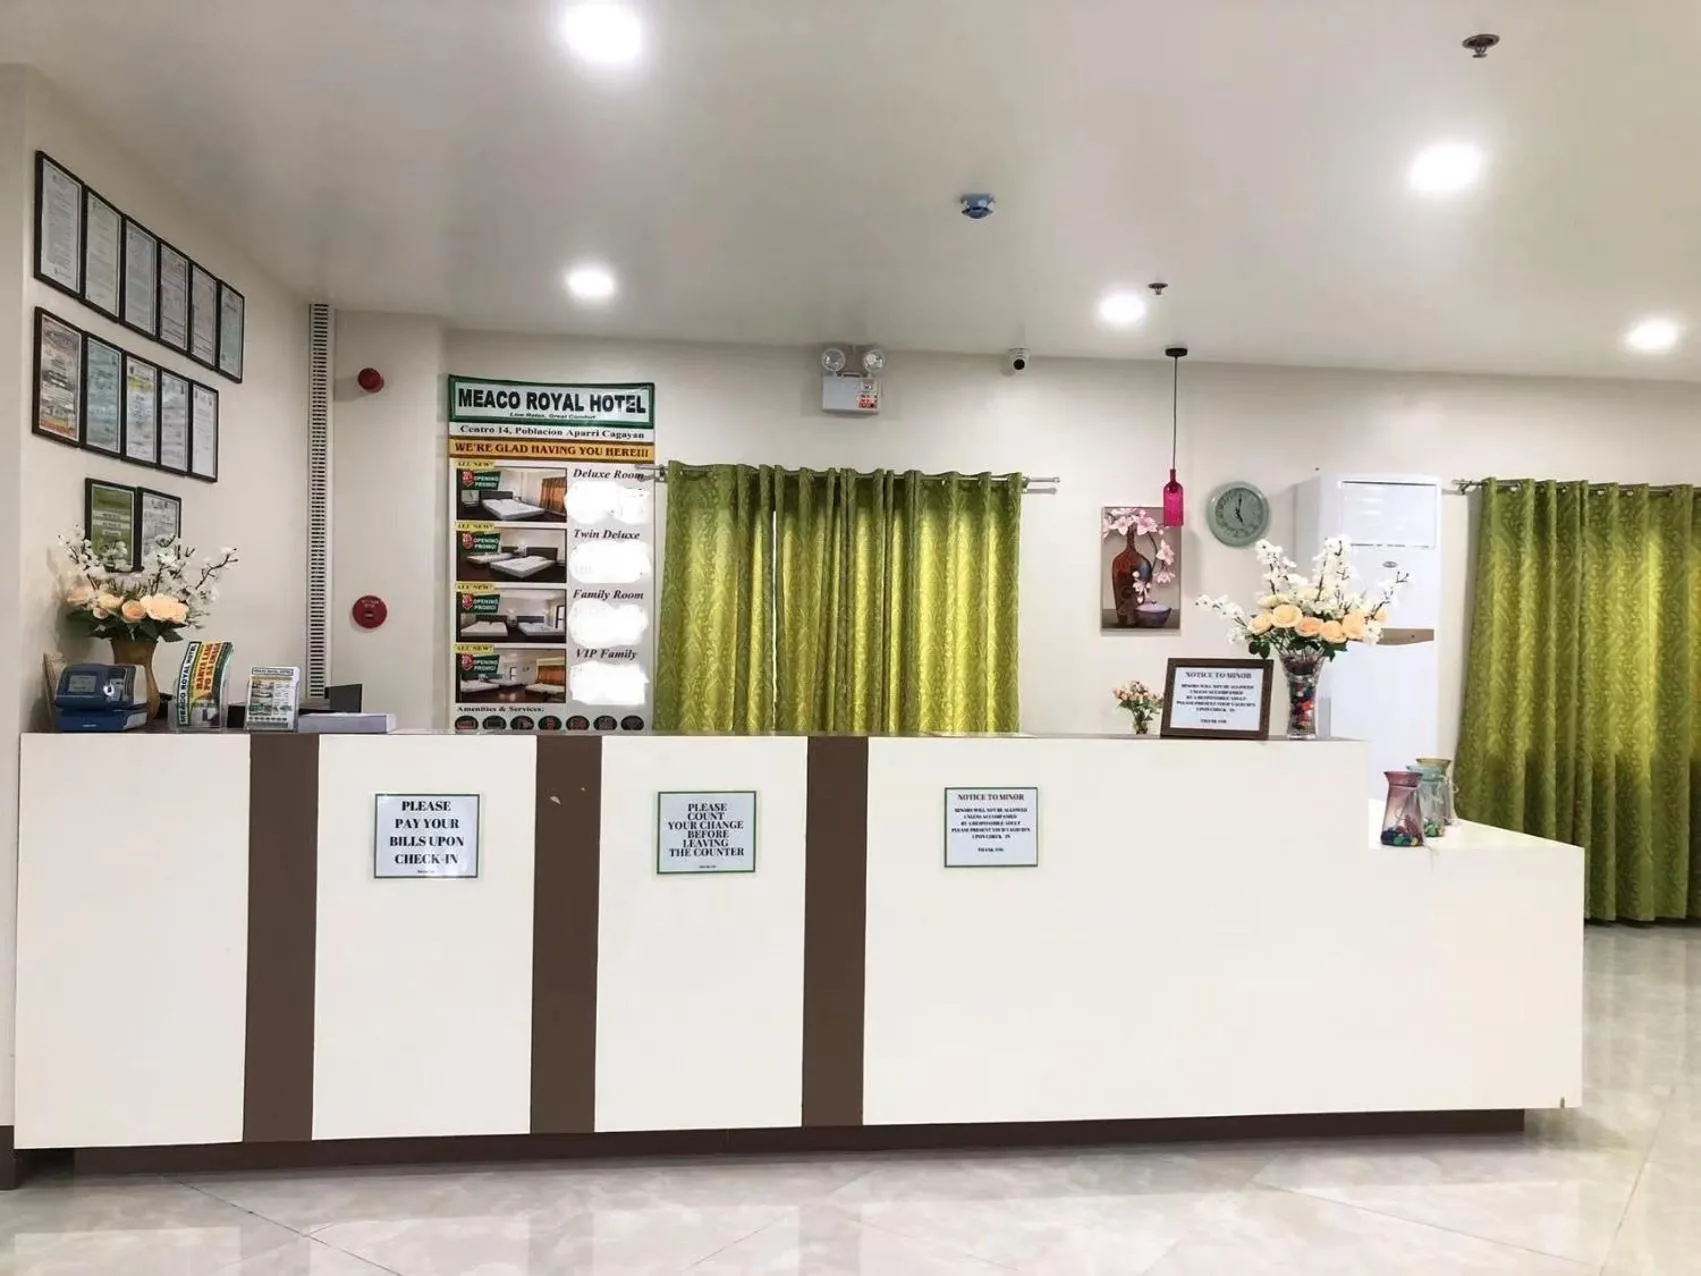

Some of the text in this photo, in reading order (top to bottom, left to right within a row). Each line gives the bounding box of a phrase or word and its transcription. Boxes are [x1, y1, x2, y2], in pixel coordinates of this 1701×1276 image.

[458, 388, 646, 413] MEACO ROYAL HOTEL
[460, 425, 495, 433] Centro
[515, 427, 562, 435] Poblacion
[602, 430, 644, 439] Cagayan
[455, 442, 492, 452] WE'RE
[495, 443, 528, 452] GLAD
[531, 444, 576, 454] HAVING
[580, 447, 602, 455] YOU
[572, 469, 644, 479] Deluxe Room
[574, 529, 640, 539] Twin Deluxe
[573, 589, 644, 601] Family Room
[576, 649, 637, 660] VIP Family
[181, 665, 190, 690] ROYAL
[402, 801, 451, 811] PLEASE
[688, 803, 727, 812] PLEASE
[687, 812, 725, 820] COUNT
[395, 818, 460, 828] PAY YOUR
[668, 821, 744, 830] YOUR CHANGE
[687, 830, 729, 838] BEFORE
[390, 836, 464, 846] BILLS UPON
[683, 839, 729, 848] LEAVING
[669, 847, 744, 857] THE COUNTER
[394, 854, 458, 864] CHECK-IN
